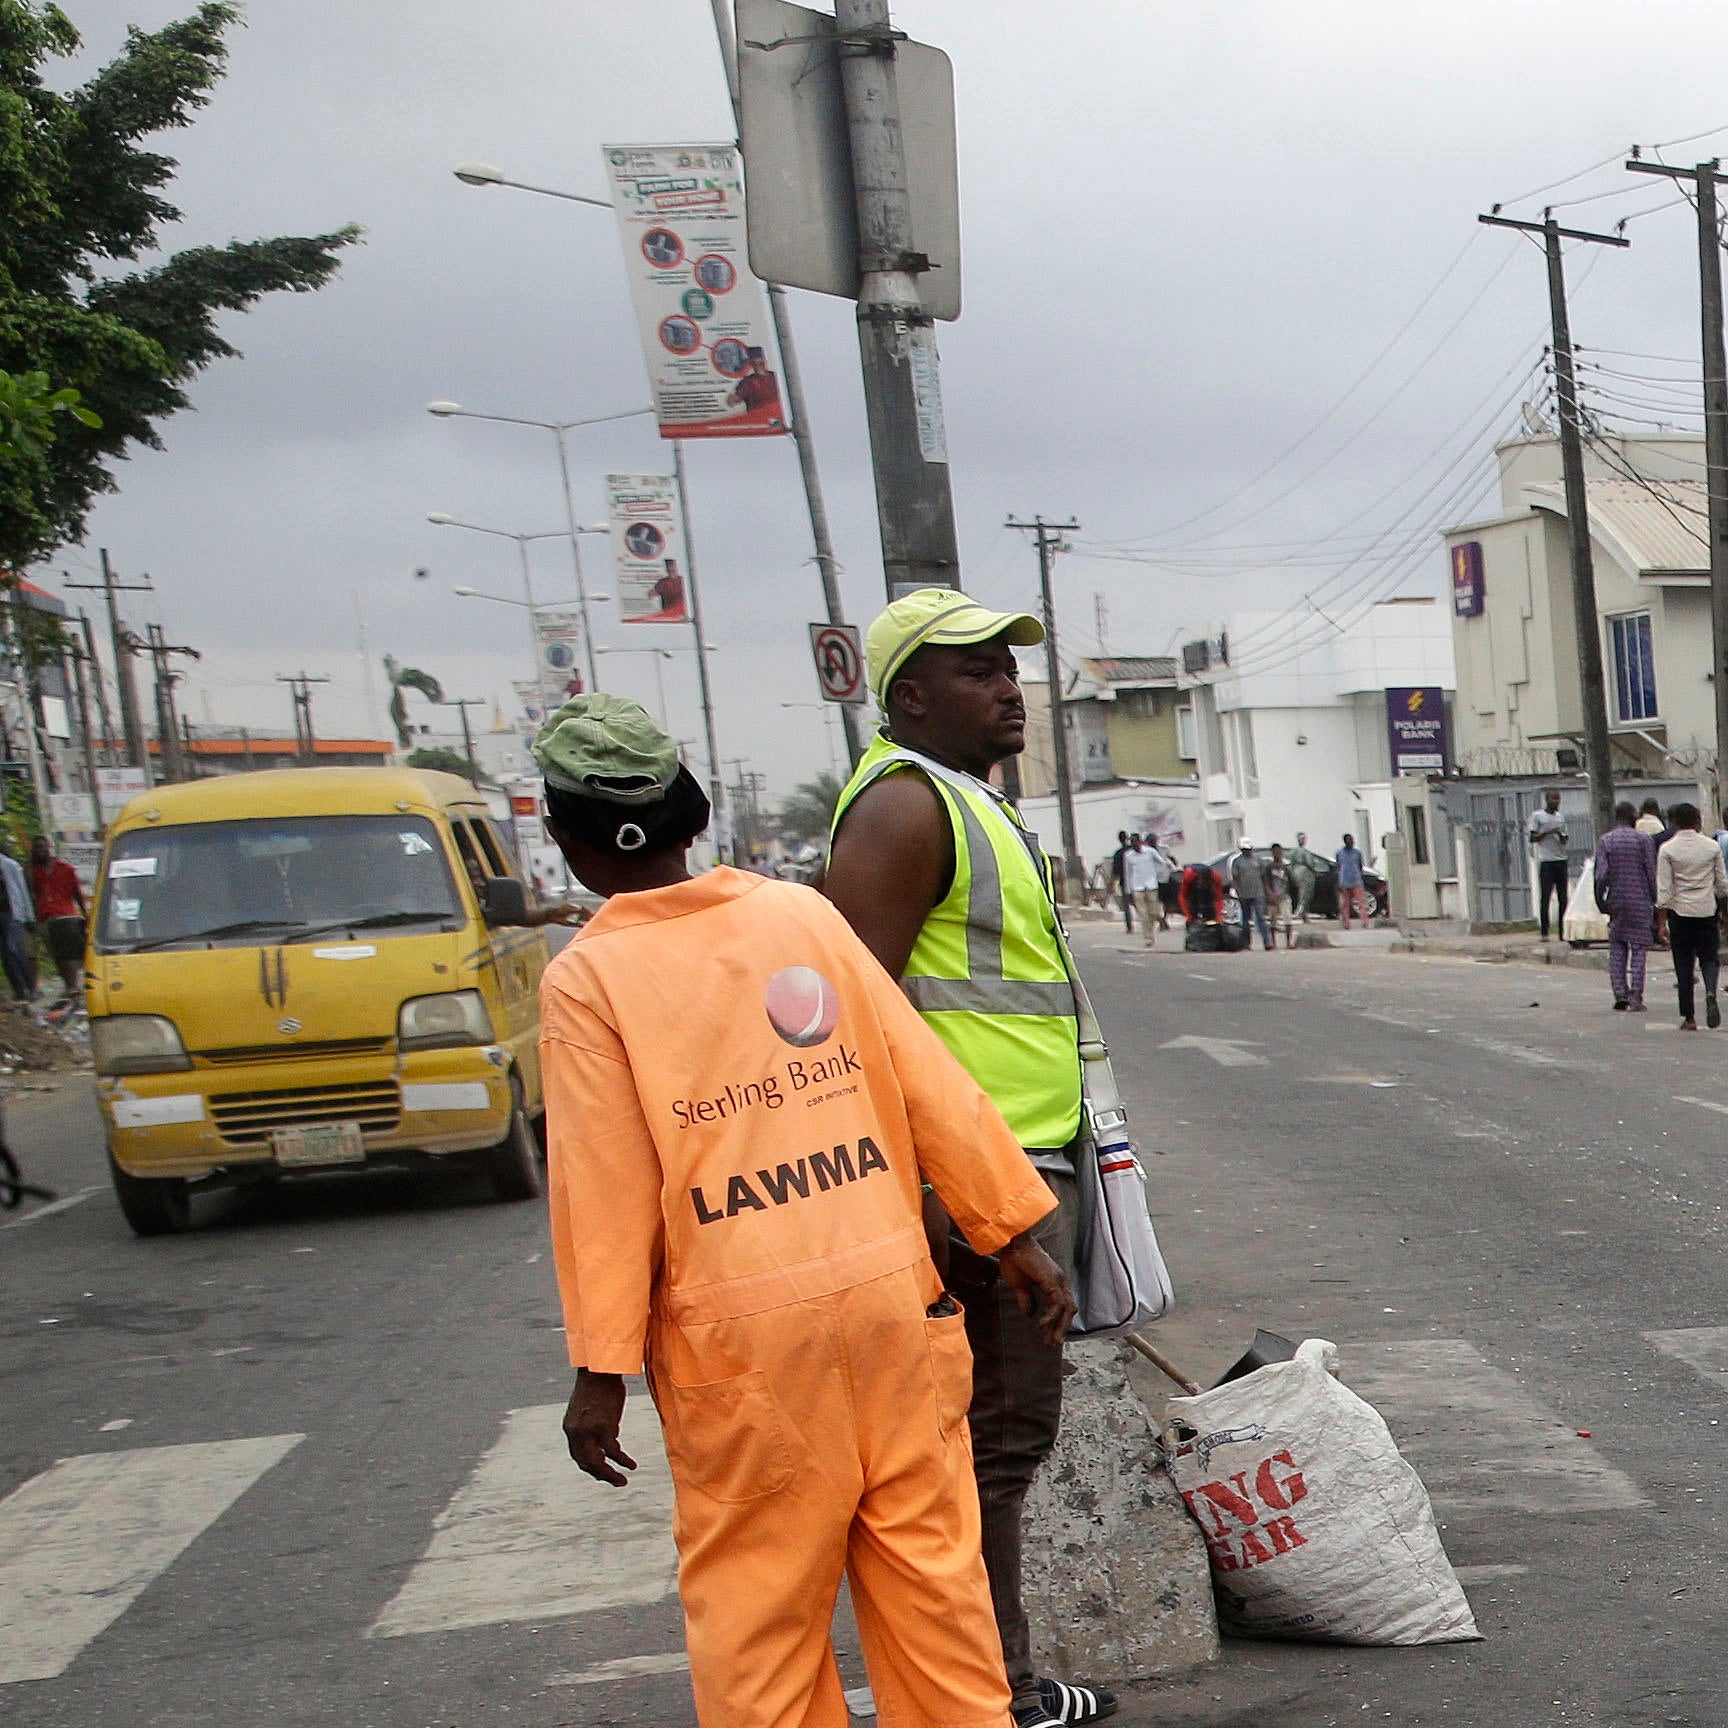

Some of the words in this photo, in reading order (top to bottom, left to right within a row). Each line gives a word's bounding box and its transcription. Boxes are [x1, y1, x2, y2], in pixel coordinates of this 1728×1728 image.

[1393, 719, 1441, 731] POLARIS
[1401, 730, 1436, 740] BANK
[787, 1044, 862, 1091] Bank
[672, 1075, 784, 1129] Sterling
[806, 1095, 824, 1108] CSR
[825, 1084, 859, 1101] INITIATIVE
[690, 1136, 889, 1225] LAWMA
